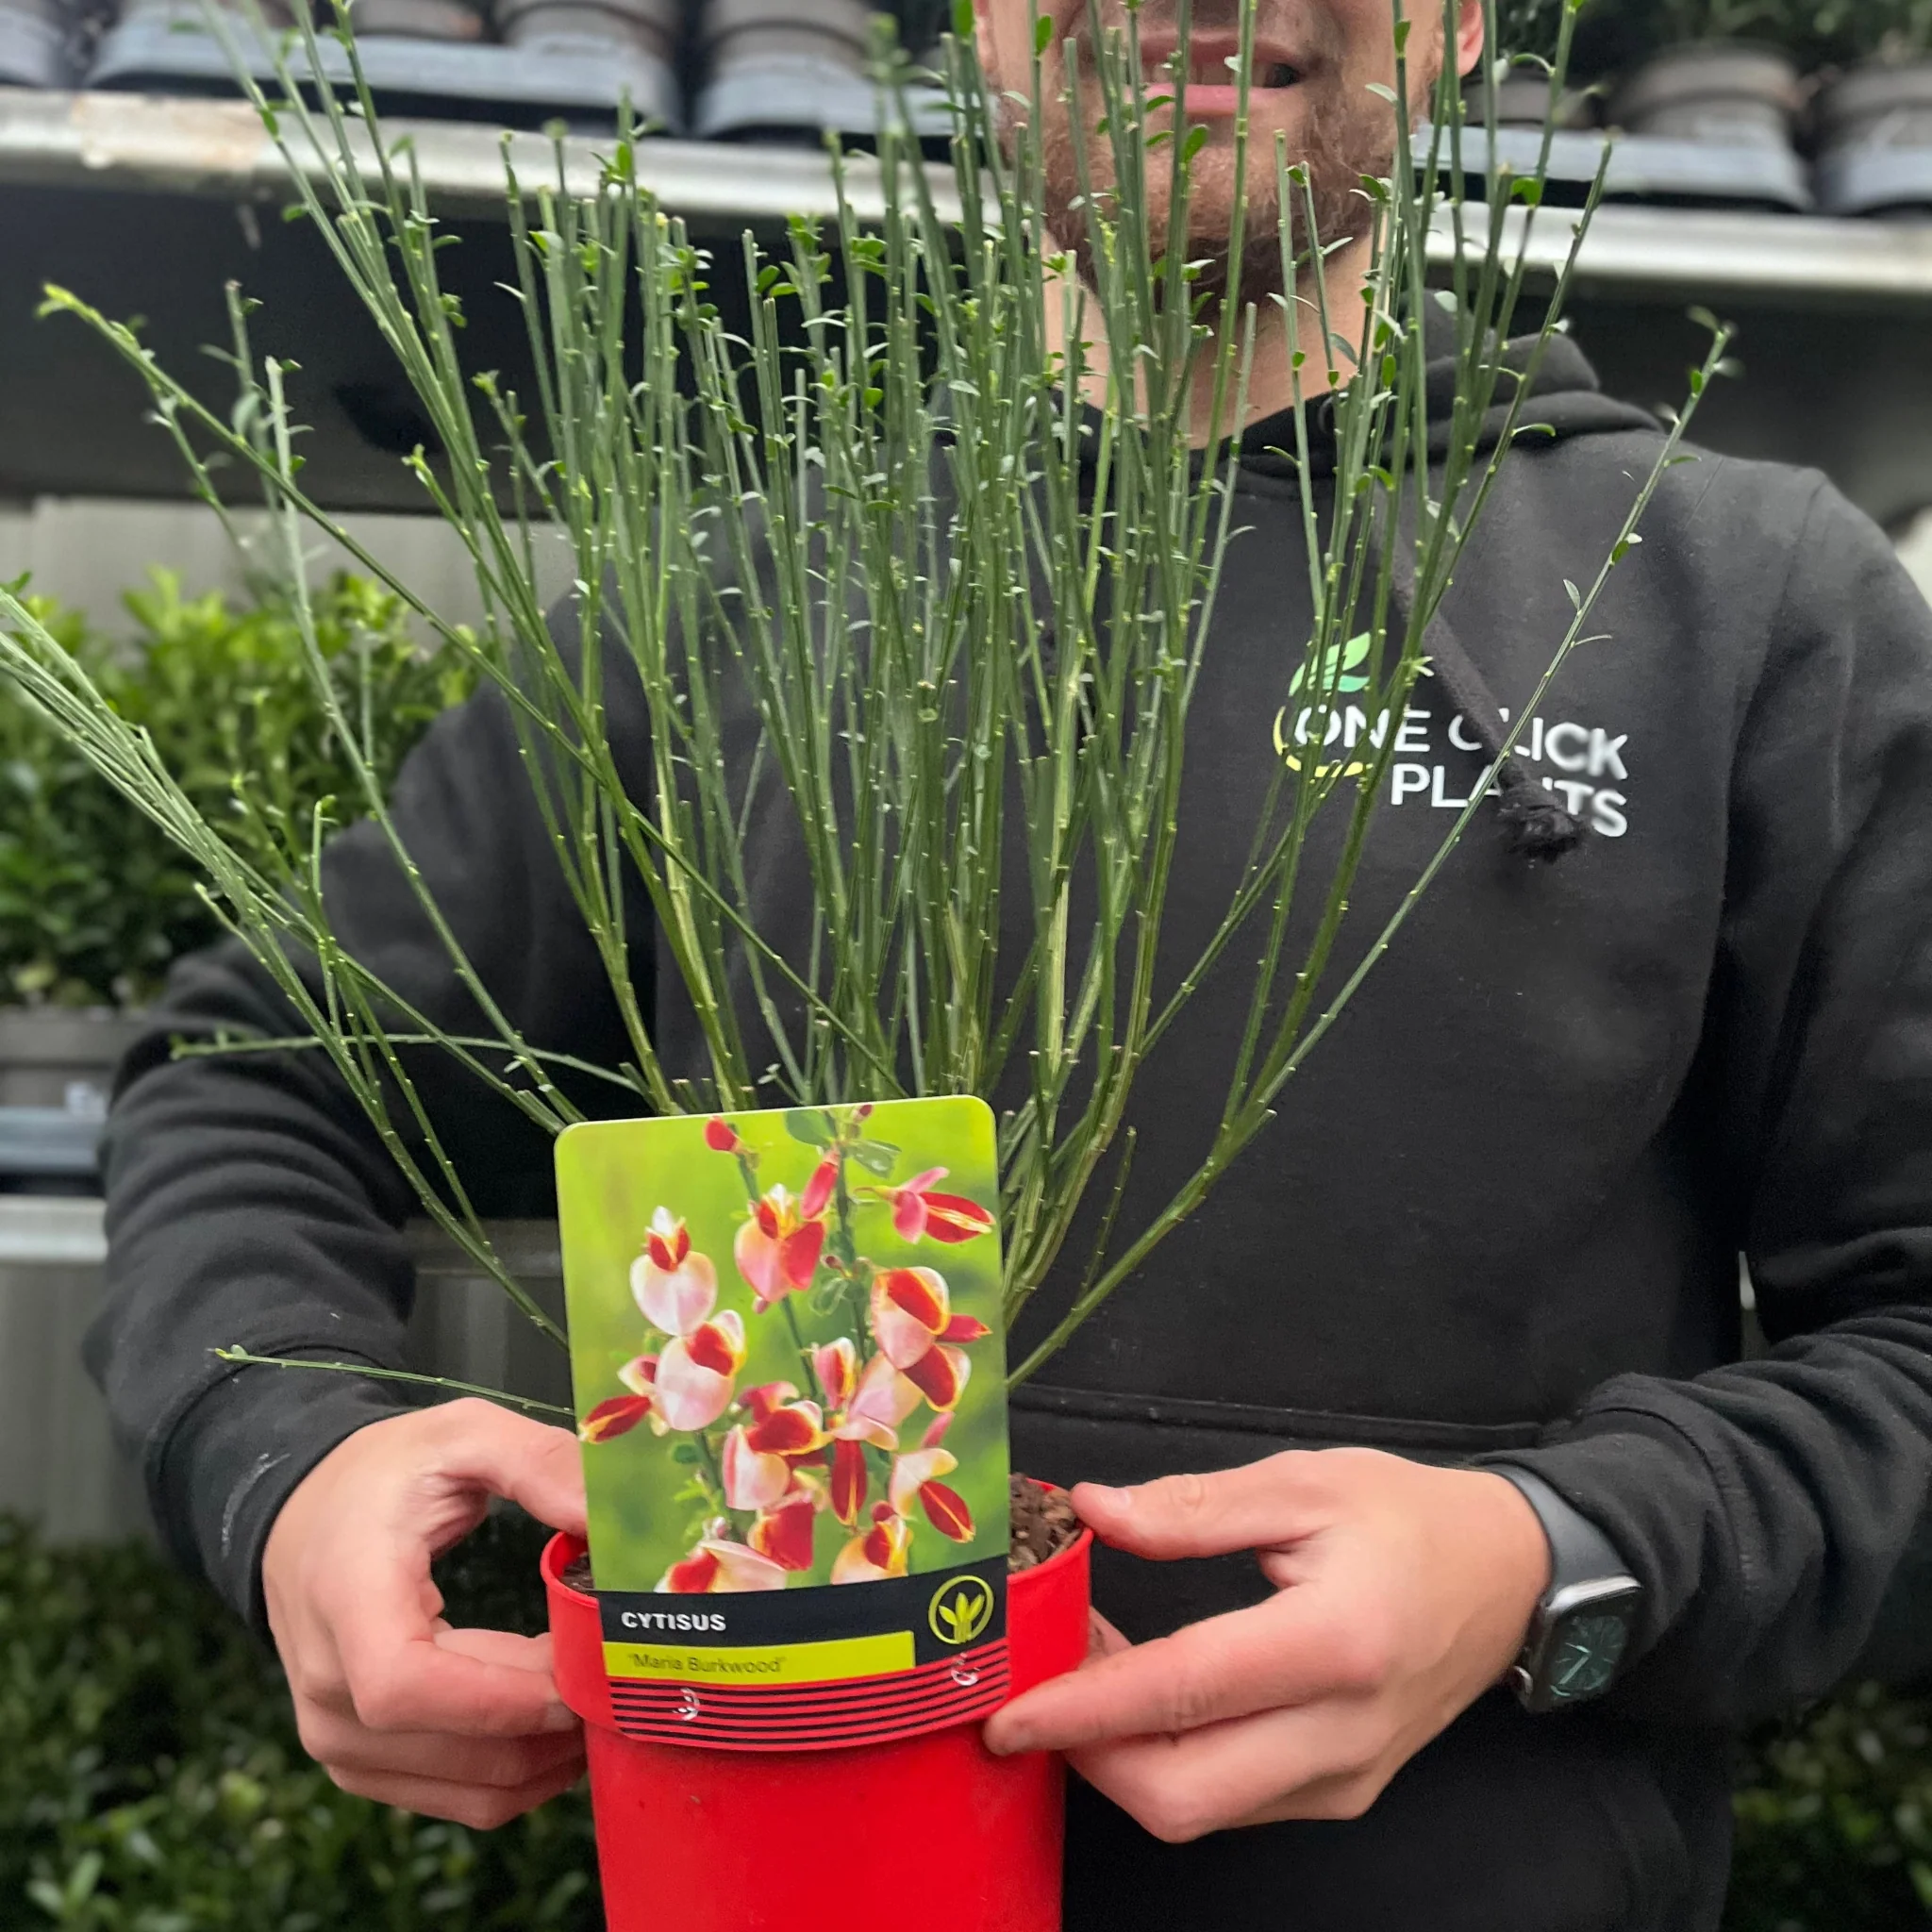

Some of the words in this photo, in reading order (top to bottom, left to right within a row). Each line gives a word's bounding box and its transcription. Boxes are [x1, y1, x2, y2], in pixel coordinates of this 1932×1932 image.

[1294, 705, 1431, 752] ONE
[1391, 763, 1627, 837] PLATS
[621, 1611, 726, 1631] CYTISUS
